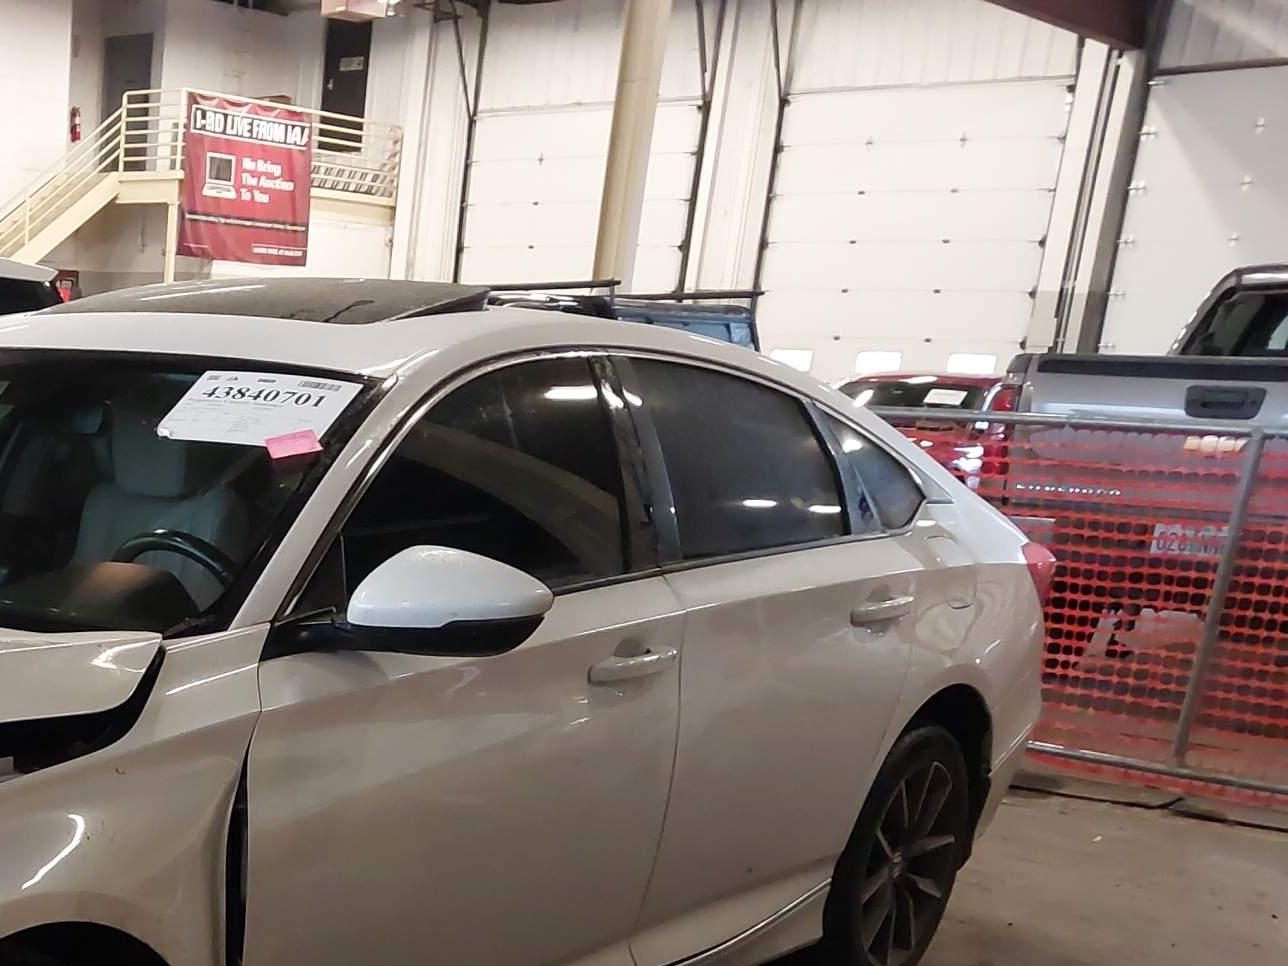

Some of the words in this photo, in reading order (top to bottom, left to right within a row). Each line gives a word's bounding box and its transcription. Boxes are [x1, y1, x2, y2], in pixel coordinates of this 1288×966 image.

[226, 115, 253, 138] LIVE
[252, 119, 286, 143] FROM
[202, 386, 326, 408] 43840701
